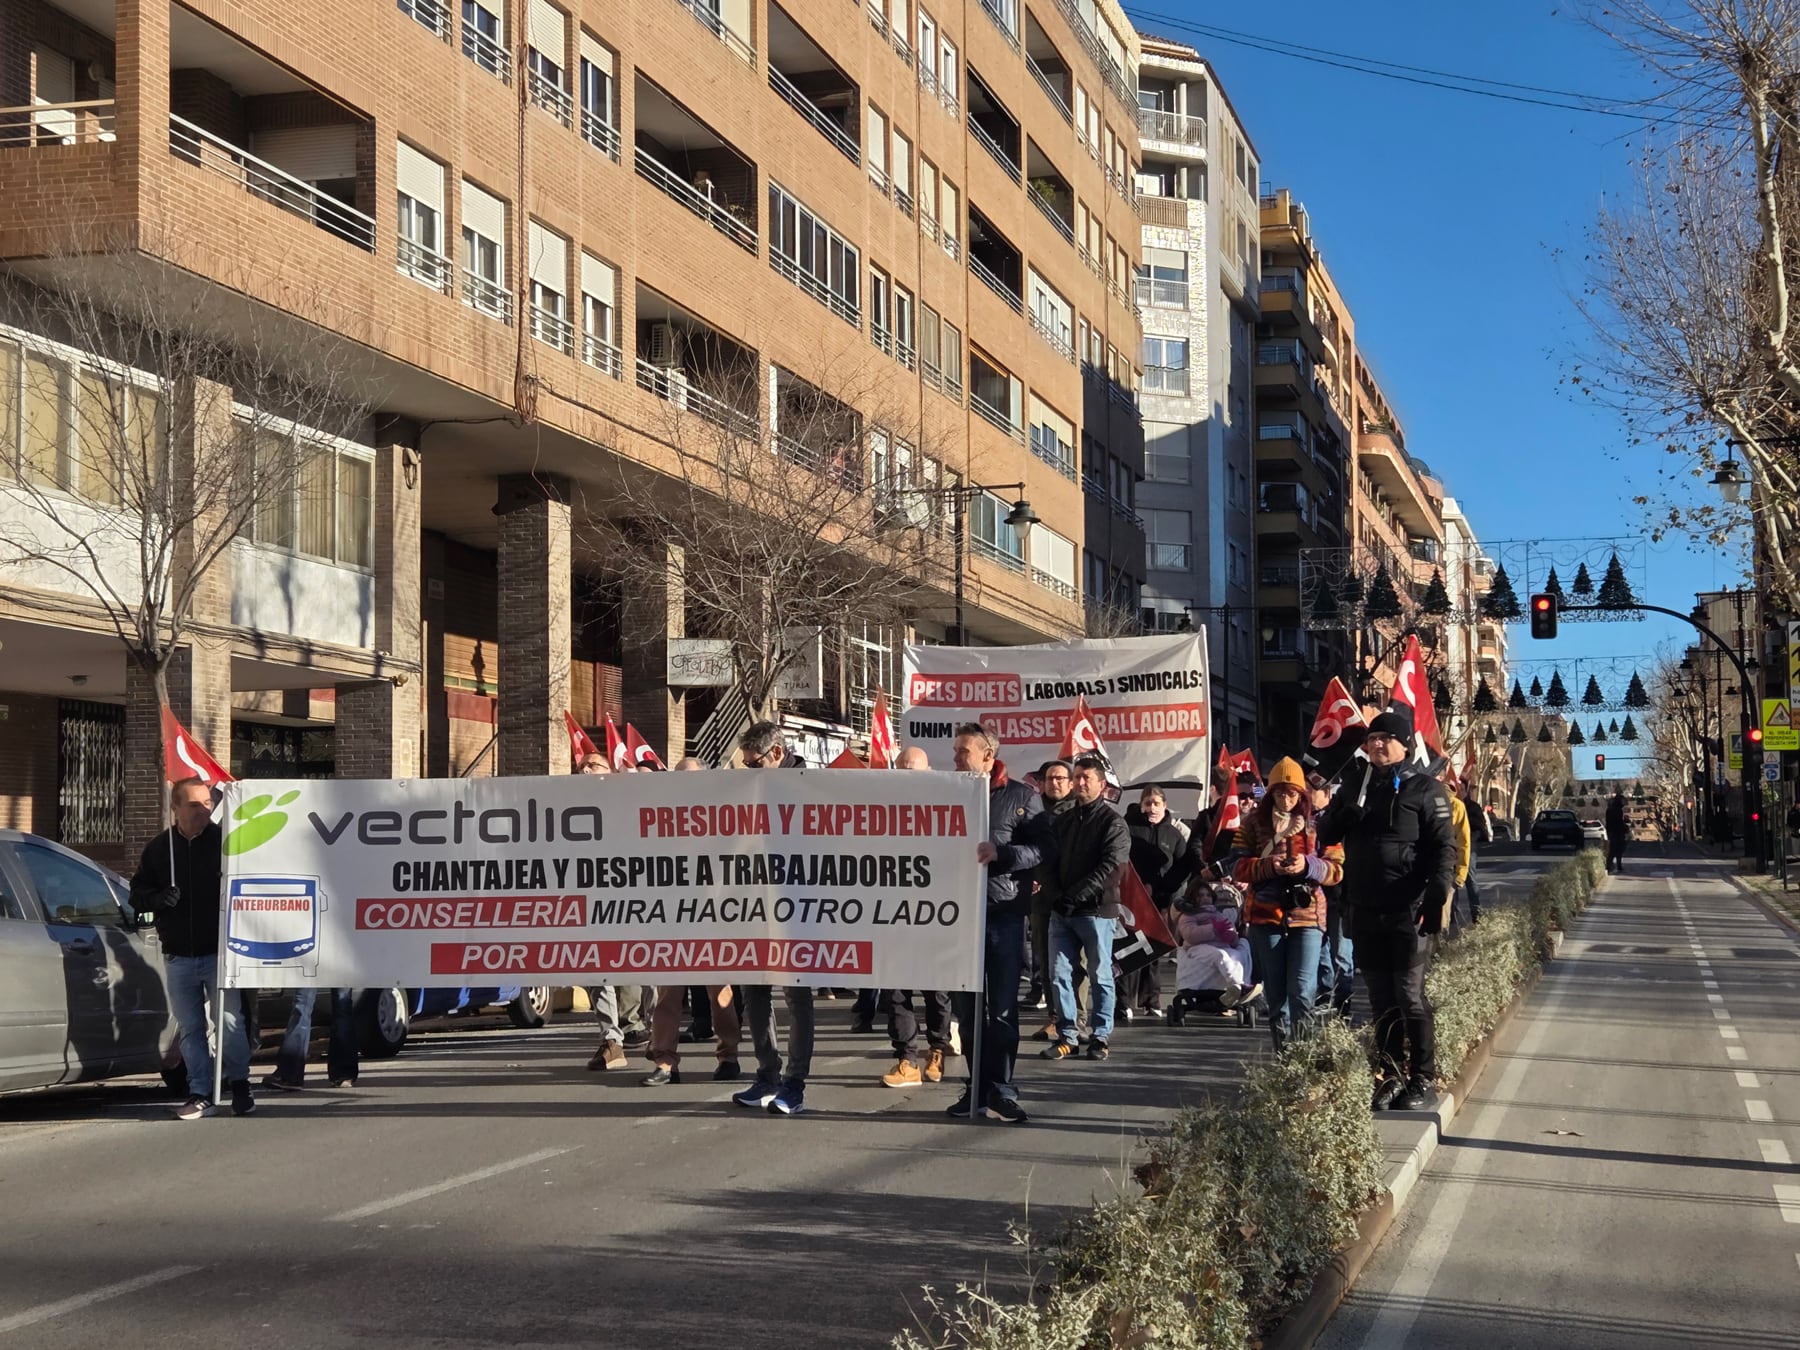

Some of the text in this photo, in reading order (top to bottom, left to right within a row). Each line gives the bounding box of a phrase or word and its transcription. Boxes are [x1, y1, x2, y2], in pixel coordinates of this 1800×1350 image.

[913, 669, 1202, 702] PELS DRETS LABORALS I SINDICALS:
[307, 798, 968, 846] vectalia PRESIONA Y EXPEDIENTA
[392, 853, 931, 892] CHANTAJEA Y DESPIDE A TRABAJADORES
[232, 898, 310, 912] INTERURBANO
[363, 896, 959, 928] CONSELLERÍA MIRA HACIA OTRO LADO
[461, 941, 860, 970] POR UNA JORNADA DIGNA
